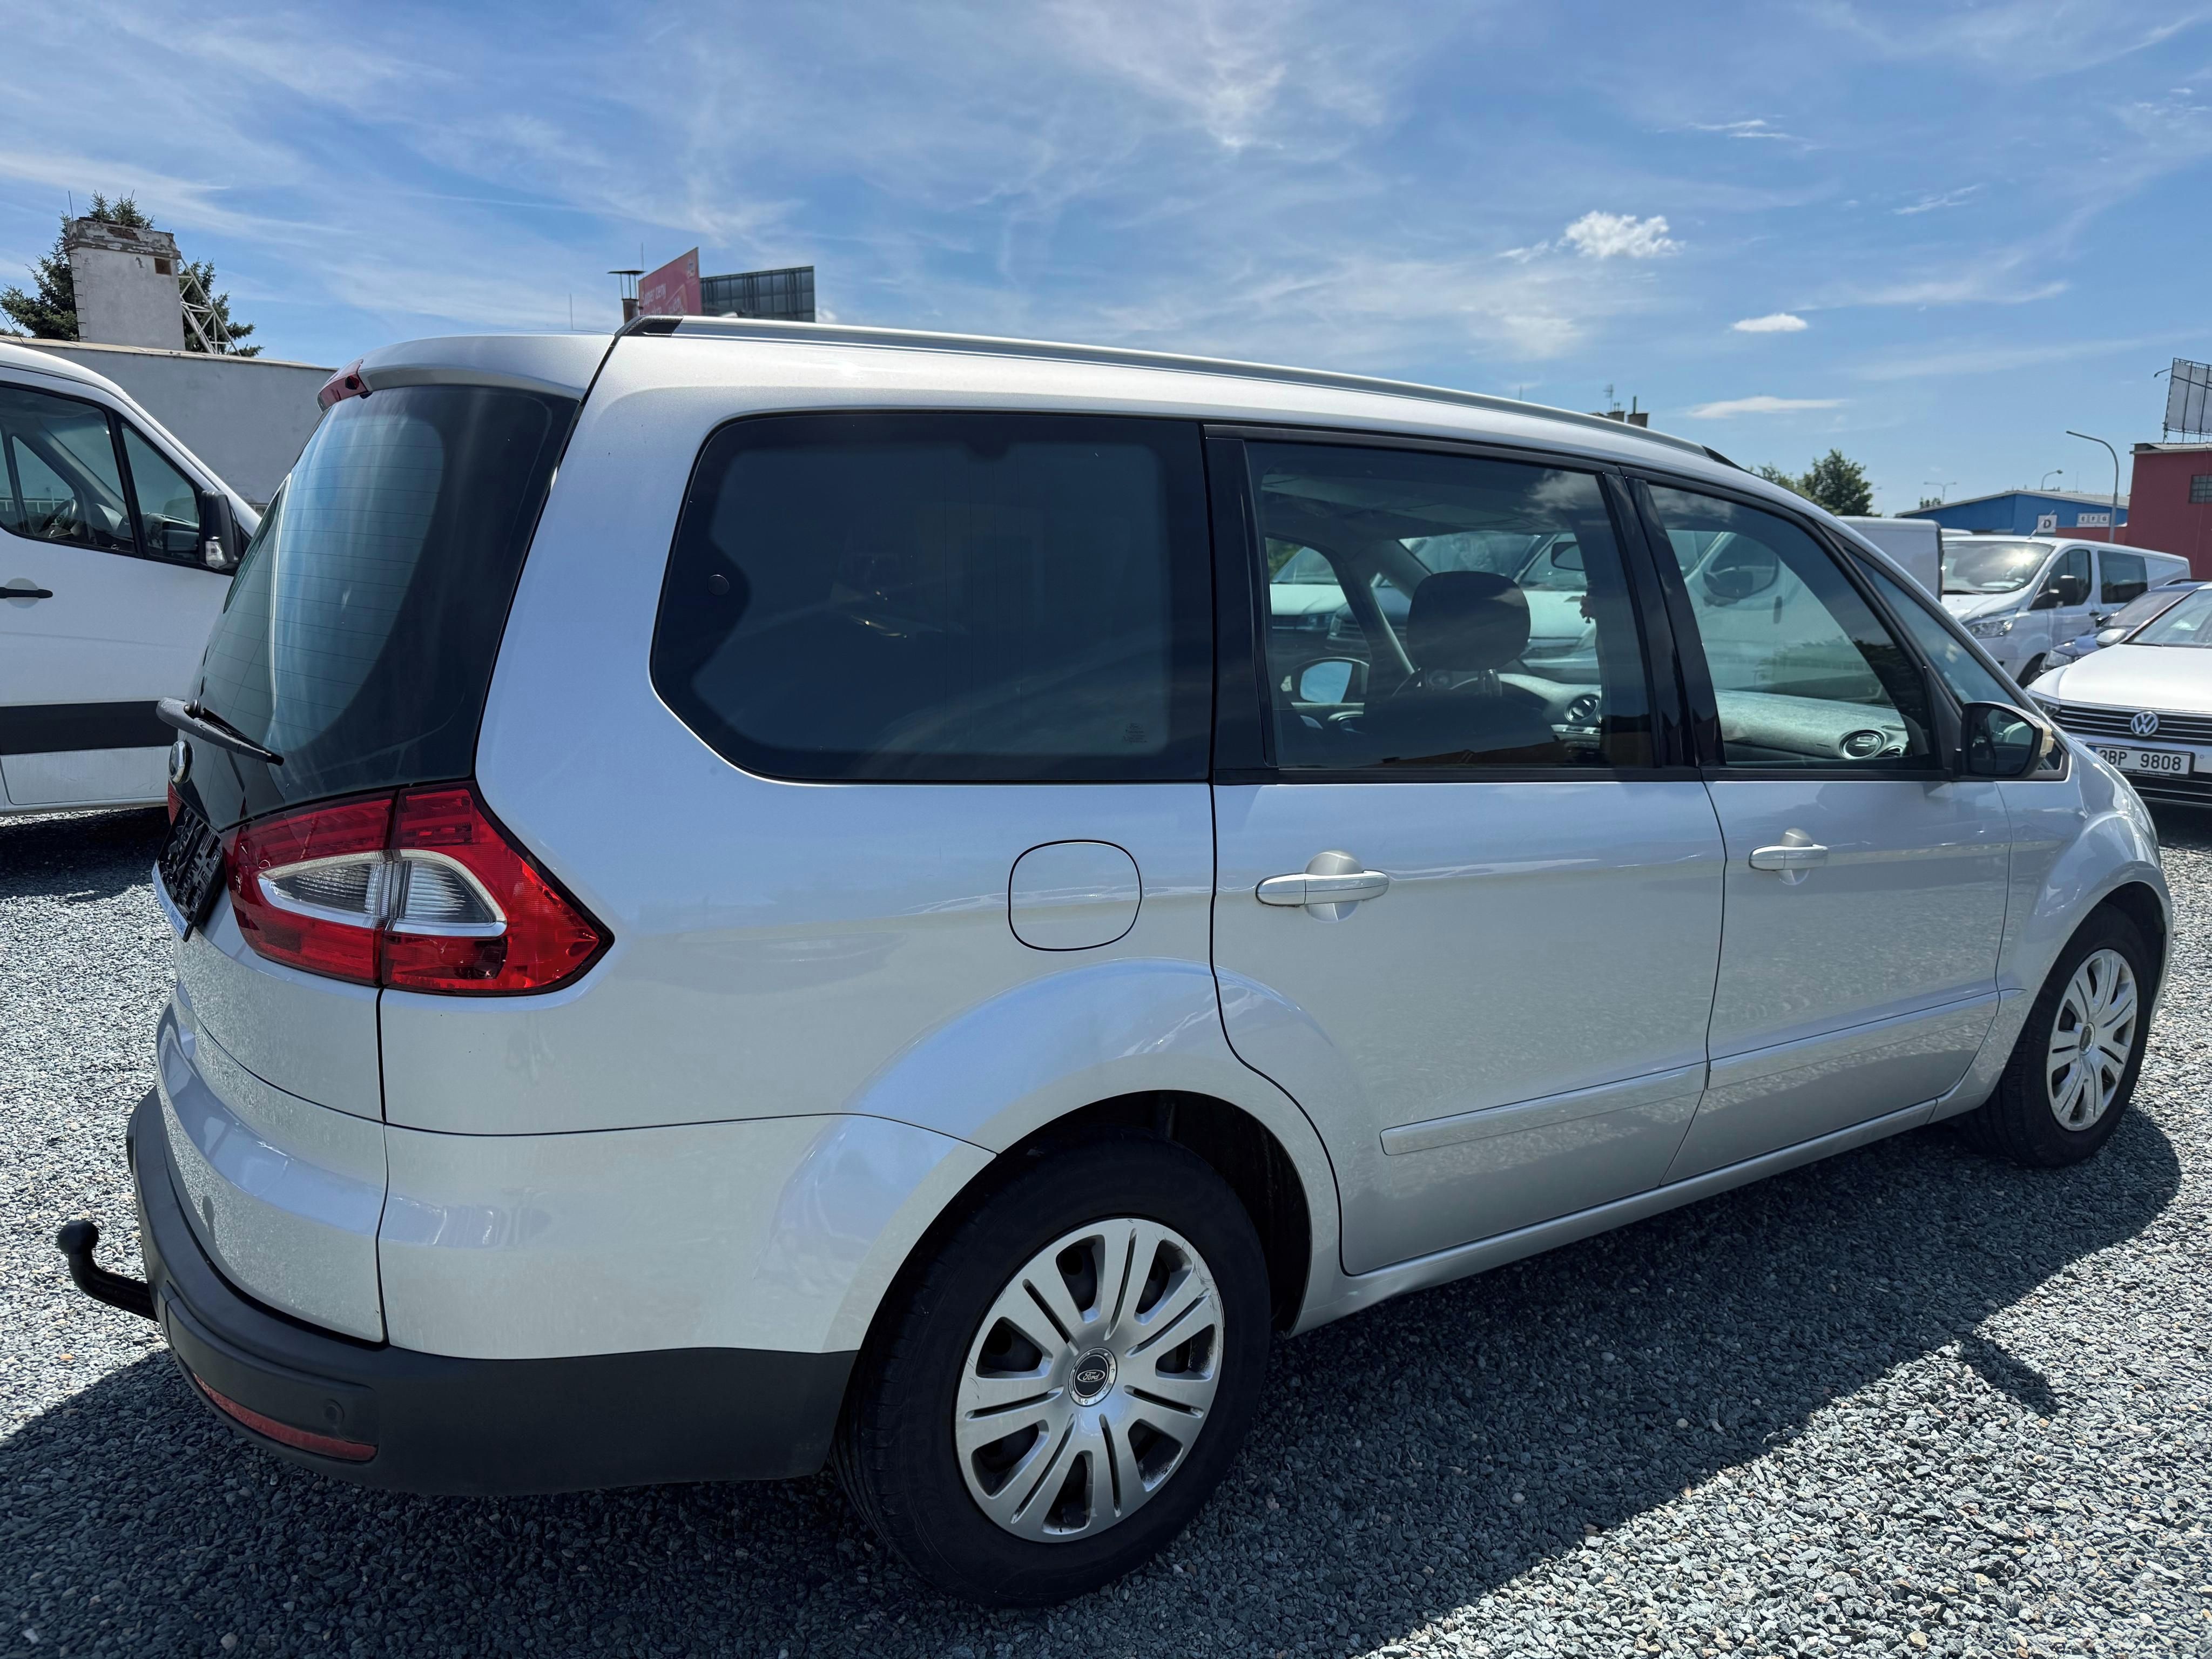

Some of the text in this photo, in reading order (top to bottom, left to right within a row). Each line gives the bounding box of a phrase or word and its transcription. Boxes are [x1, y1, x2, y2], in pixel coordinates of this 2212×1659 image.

[2043, 519, 2052, 529] D
[2099, 750, 2182, 771] 3BP 9808
[1083, 1371, 1101, 1381] Ford
